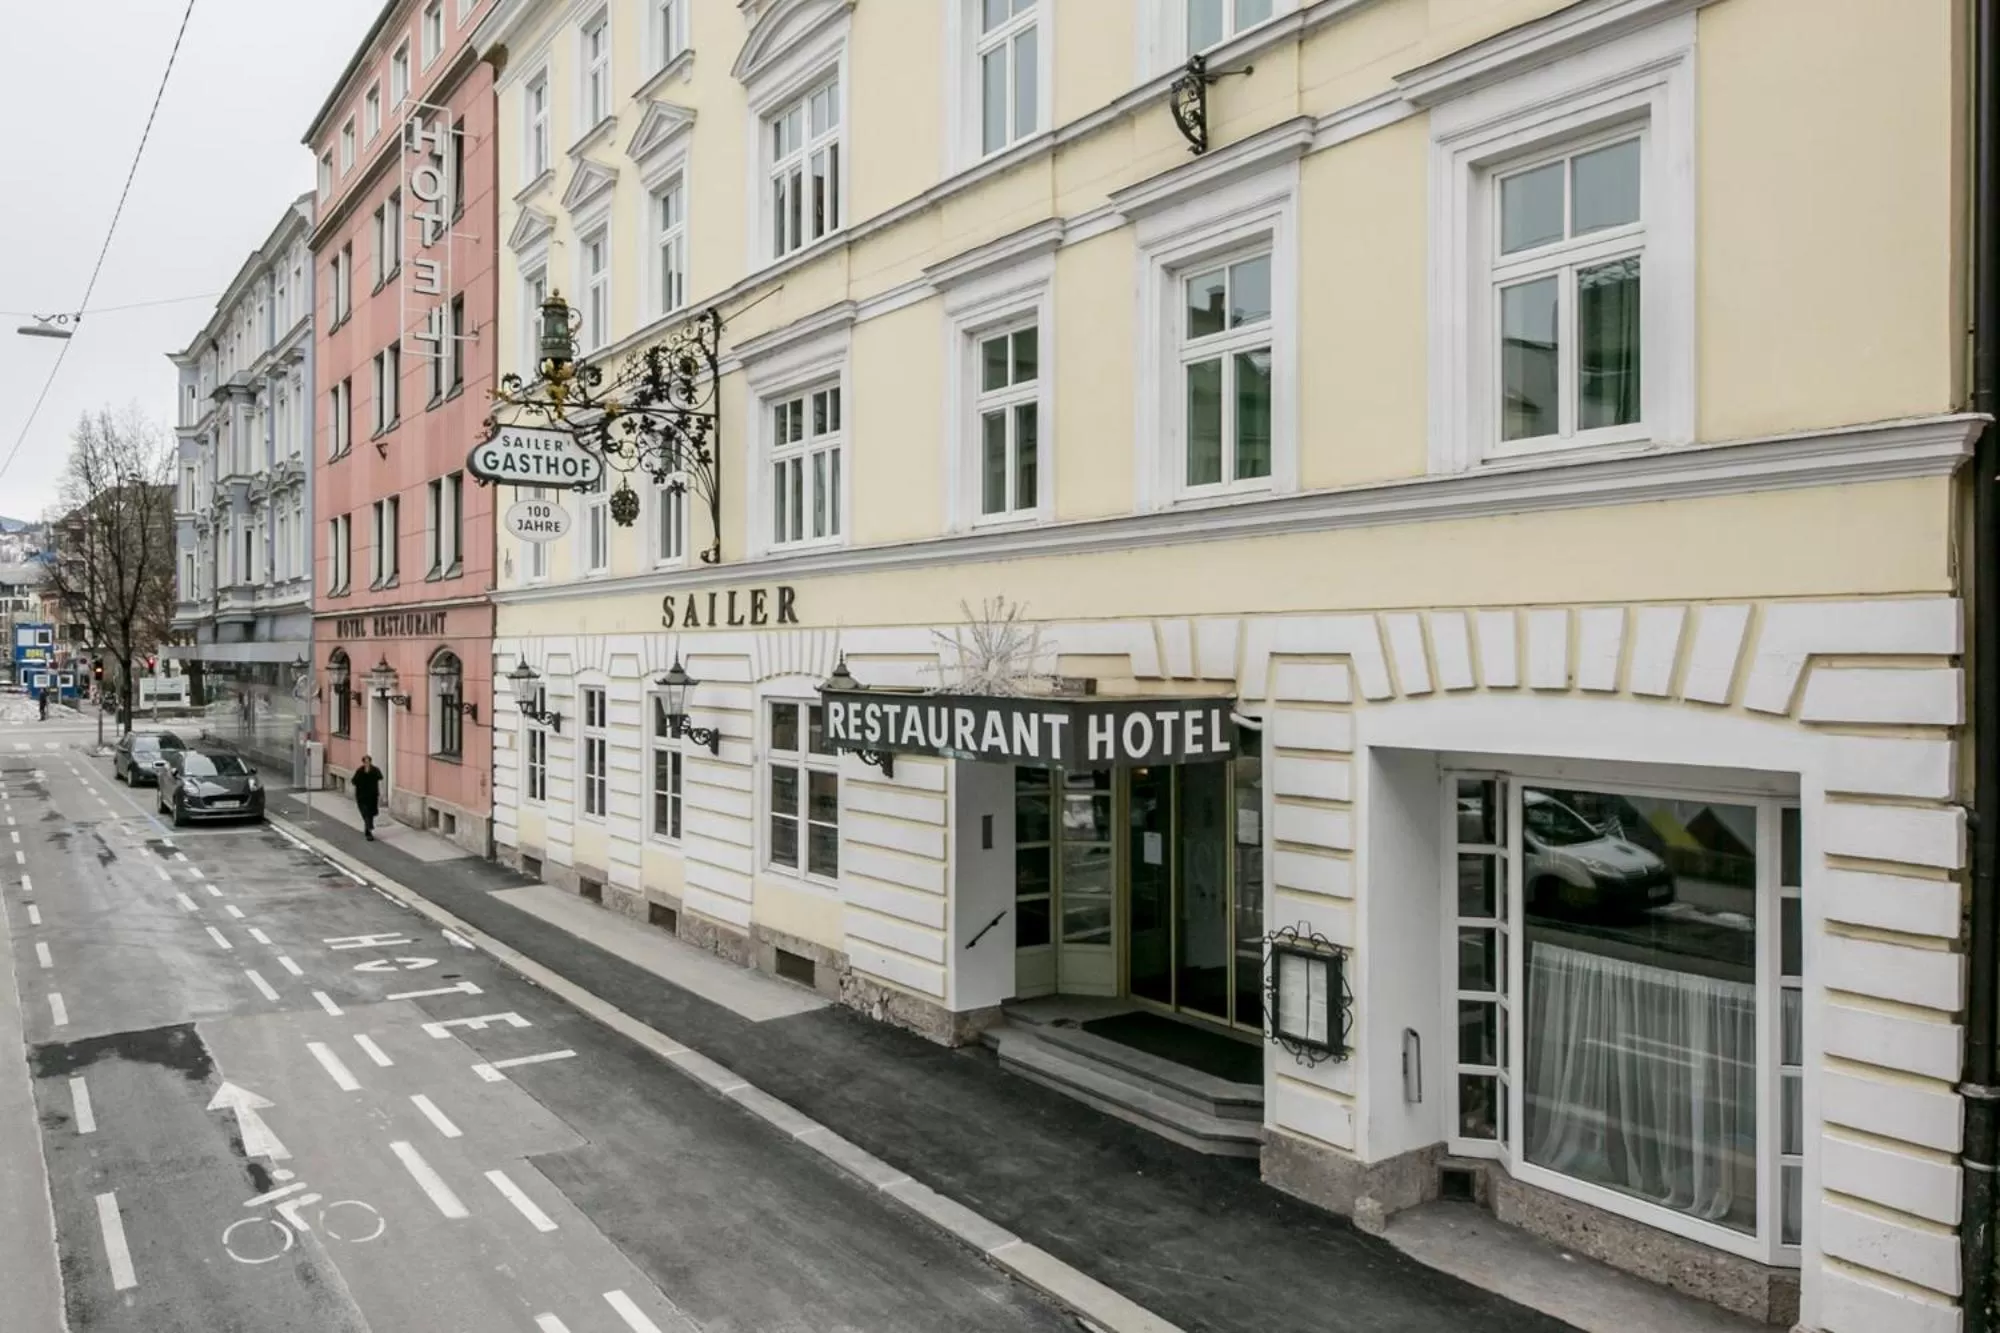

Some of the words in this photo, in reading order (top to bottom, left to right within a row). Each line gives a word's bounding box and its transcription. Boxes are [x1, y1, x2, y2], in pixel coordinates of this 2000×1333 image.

[483, 451, 591, 478] GASTHOF
[526, 506, 550, 518] 100
[517, 519, 561, 533] JAHRE
[661, 585, 799, 629] SAILER
[336, 616, 367, 639] HOTEL
[373, 611, 447, 637] RESTAURANT
[827, 701, 1069, 761] RESTAURANT
[1087, 708, 1231, 762] HOTEL
